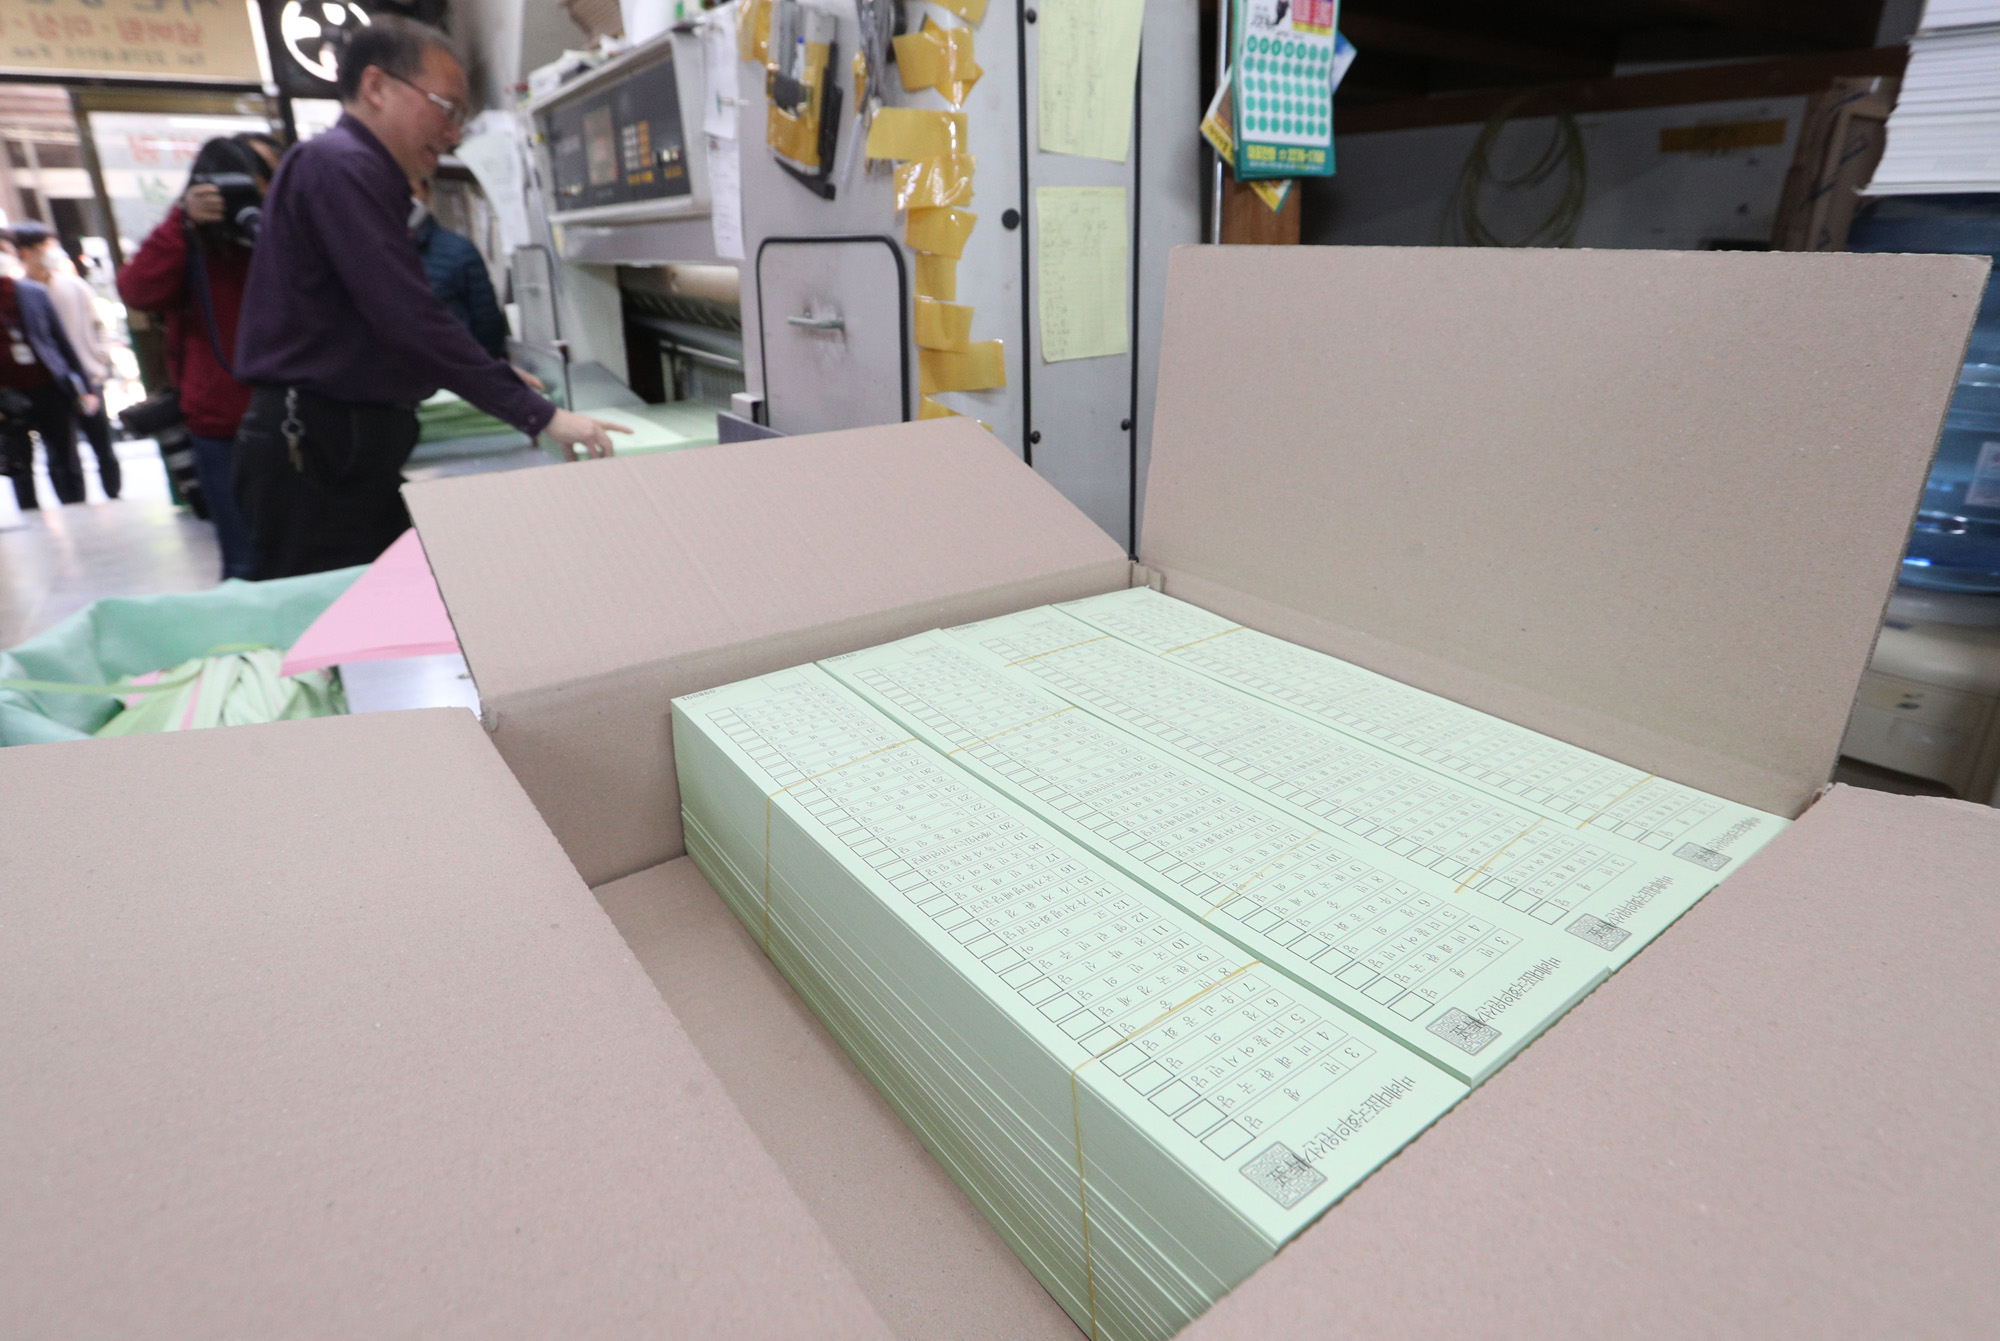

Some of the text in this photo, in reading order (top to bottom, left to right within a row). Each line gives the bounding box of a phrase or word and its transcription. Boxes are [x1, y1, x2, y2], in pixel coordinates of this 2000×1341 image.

[931, 775, 947, 783] 25
[943, 784, 960, 793] 24
[956, 792, 973, 802] 23
[1195, 787, 1209, 796] 17
[1211, 796, 1226, 805] 16
[969, 802, 986, 811] 22
[984, 811, 1000, 820] 21
[997, 820, 1014, 830] 20
[1228, 805, 1244, 814] 15
[1246, 814, 1262, 823] 14
[1265, 823, 1281, 832] 13
[1514, 820, 1527, 828] 7
[1012, 831, 1028, 841] 19
[1027, 841, 1044, 851] 18
[1044, 852, 1060, 863] 17
[1283, 832, 1300, 842] 12
[1304, 842, 1321, 852] 11
[1325, 852, 1342, 862] 10
[1536, 829, 1550, 837] 6
[1559, 838, 1575, 847] 5
[967, 863, 1076, 914] 16 국가혁명배당금당
[983, 874, 1093, 927] 15 가자환경당
[1272, 864, 1362, 915] 9 한국경제당
[1294, 875, 1384, 928] 8 민중당
[1526, 856, 1589, 896] 미래한국당
[1552, 858, 1626, 908] 3 민생당
[1000, 886, 1111, 941] 14 가자!평화인권당
[1017, 898, 1130, 955] 13 코리아
[1317, 886, 1408, 941] 7 우리공화당
[1341, 898, 1430, 955] 6 정의당
[1035, 911, 1149, 970] 12 열린민주당
[1054, 924, 1169, 985] 11 친박신당
[1365, 910, 1457, 969] 5 더불어시민당
[1391, 923, 1480, 984] 4 미래한국당
[1074, 937, 1190, 1001] 10 국민의당
[1095, 952, 1209, 1017] 9 한국경제당
[1418, 935, 1510, 1000] 3 민생당
[1117, 966, 1233, 1034] 8 민중당
[1140, 982, 1256, 1052] 7 우리공화당
[1447, 954, 1564, 1041] 비례대표국회의원선거투표
[1163, 997, 1279, 1070] 6 정의당
[1188, 1012, 1306, 1089] 5 더불어시민당
[1213, 1030, 1329, 1109] 4 미래한국당
[1240, 1046, 1360, 1130] 3 민생당
[1265, 1072, 1419, 1188] 비례대표국회의원선거투표
